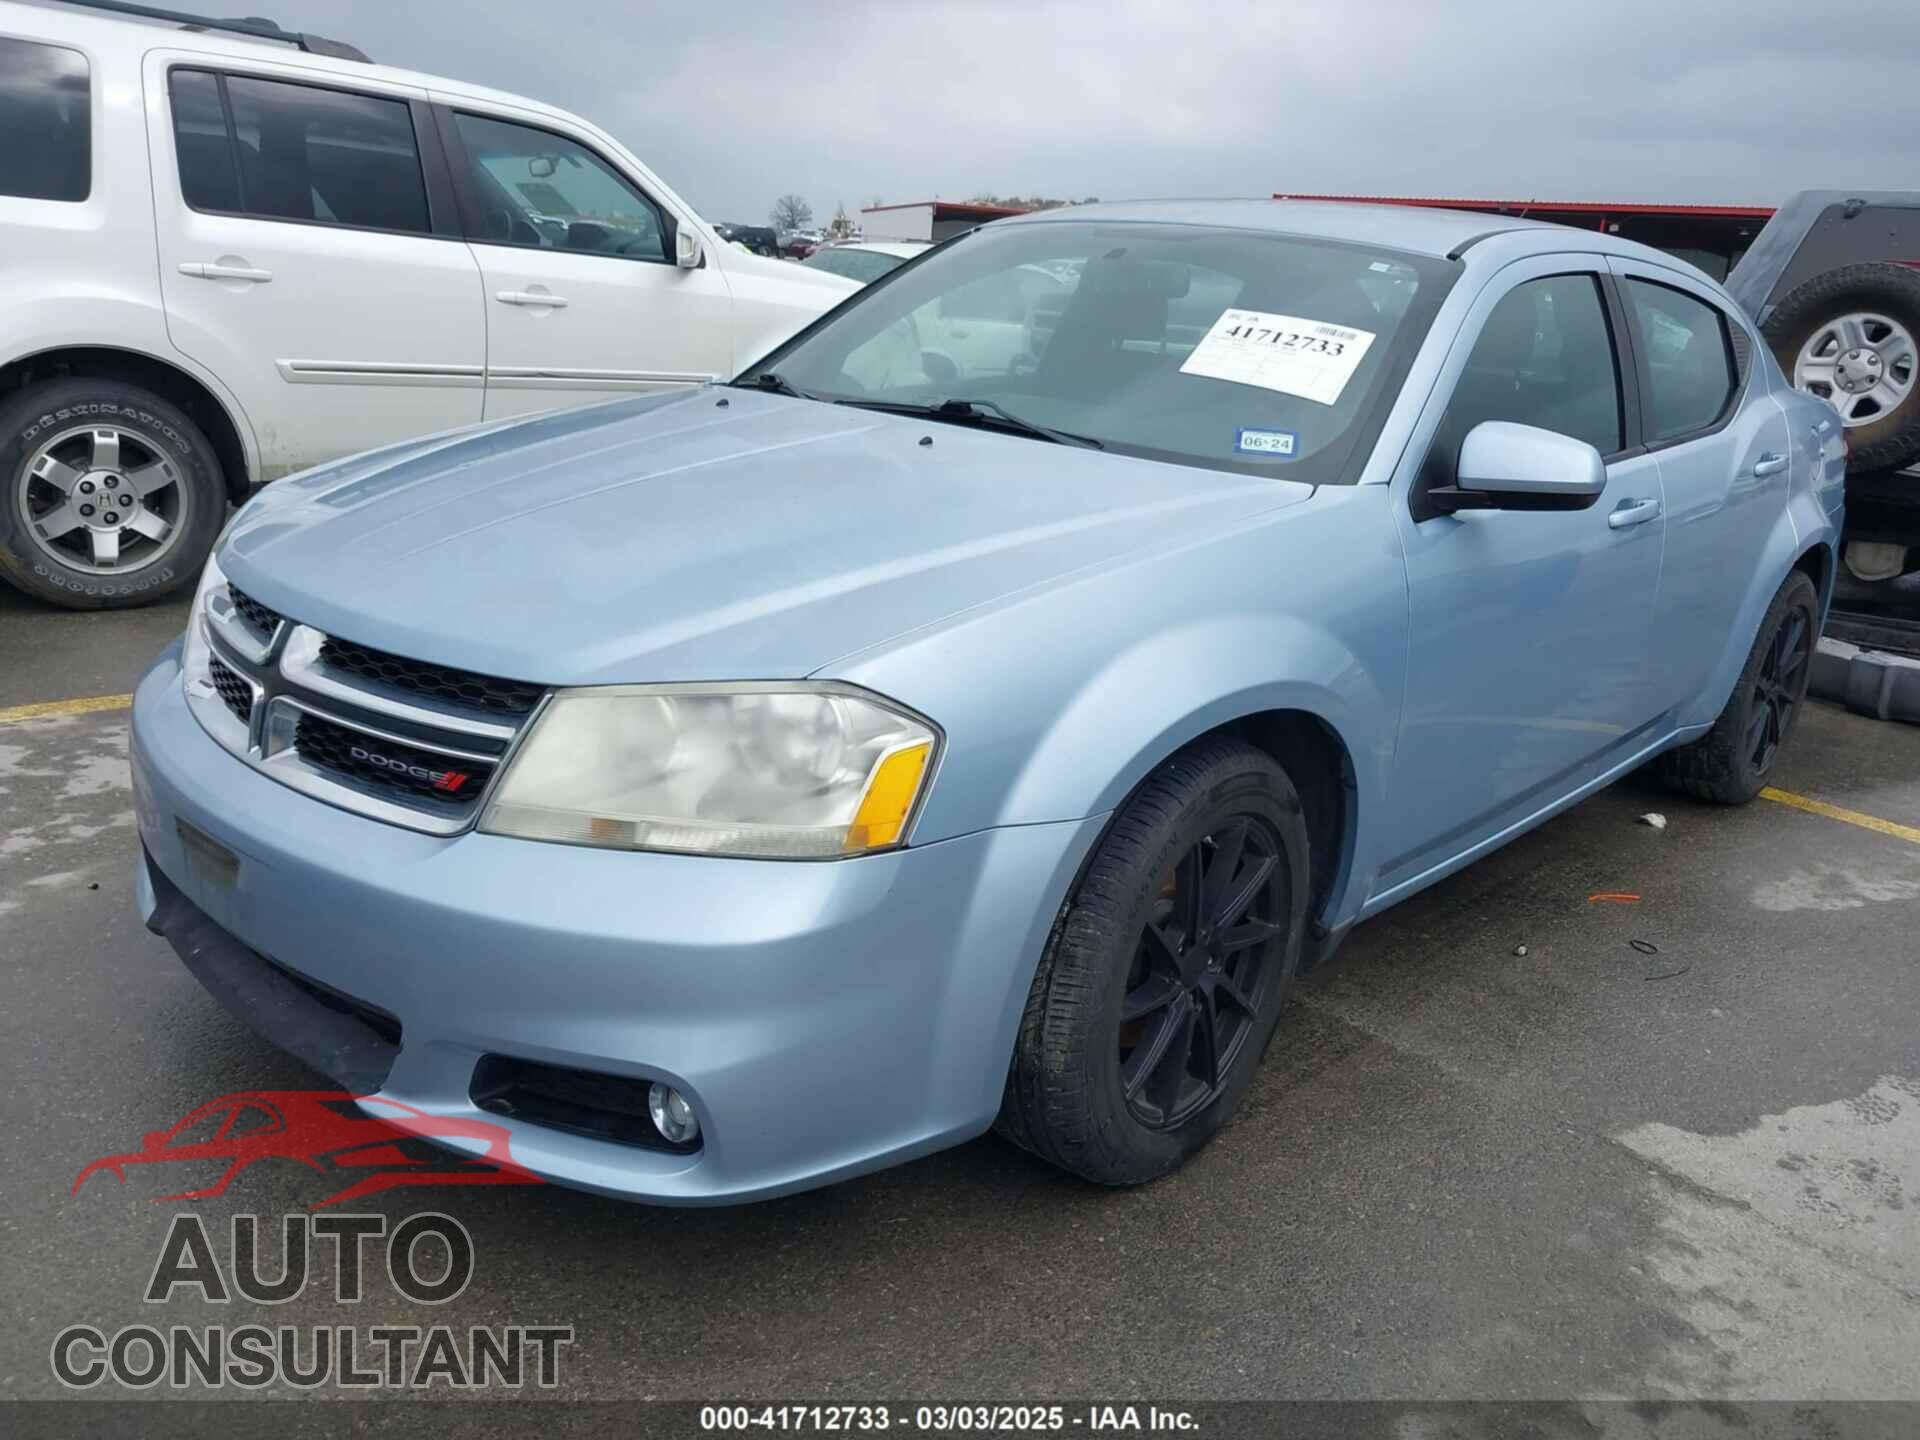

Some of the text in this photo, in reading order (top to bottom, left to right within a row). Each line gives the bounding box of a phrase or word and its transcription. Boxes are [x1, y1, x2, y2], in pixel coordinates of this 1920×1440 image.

[1226, 325, 1345, 357] 41712733
[1243, 436, 1290, 450] 06-24
[351, 746, 450, 785] DODGE
